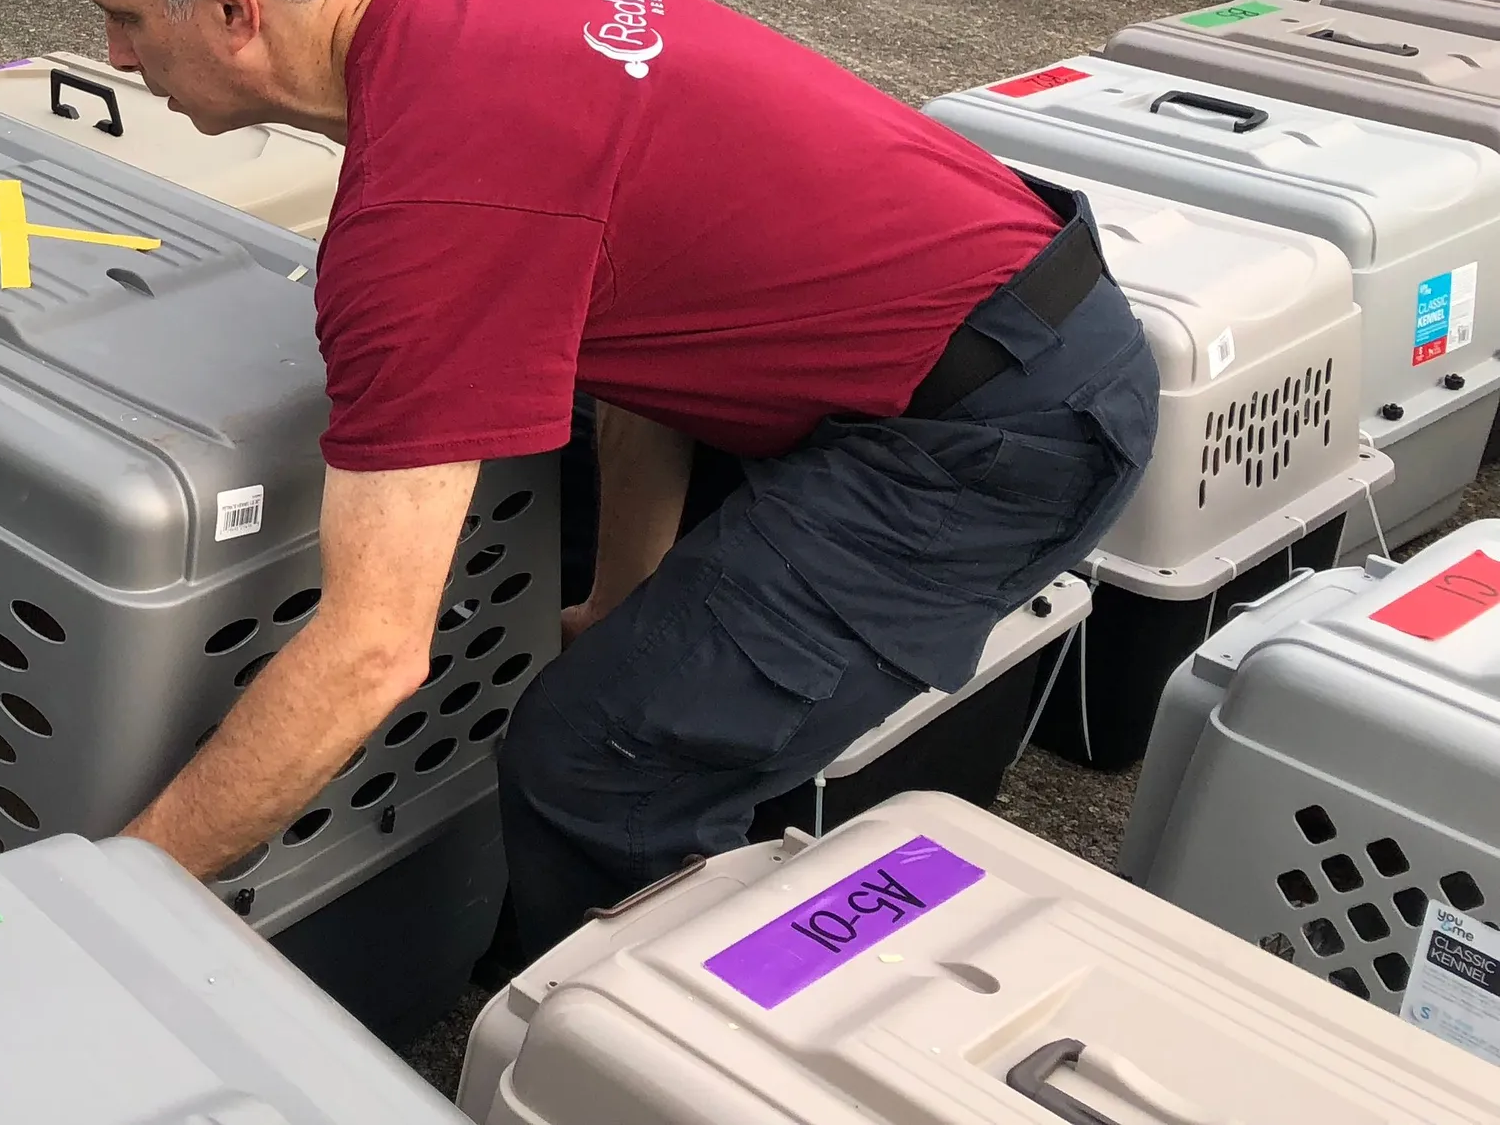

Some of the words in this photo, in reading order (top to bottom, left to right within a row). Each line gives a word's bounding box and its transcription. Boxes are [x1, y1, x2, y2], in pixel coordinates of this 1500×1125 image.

[1417, 308, 1445, 328] KENNEL
[1418, 294, 1449, 315] CLASSIC
[790, 868, 927, 954] A5-01
[1437, 908, 1464, 926] you
[1429, 947, 1490, 987] KENNEL
[1434, 936, 1497, 974] CLASSIC
